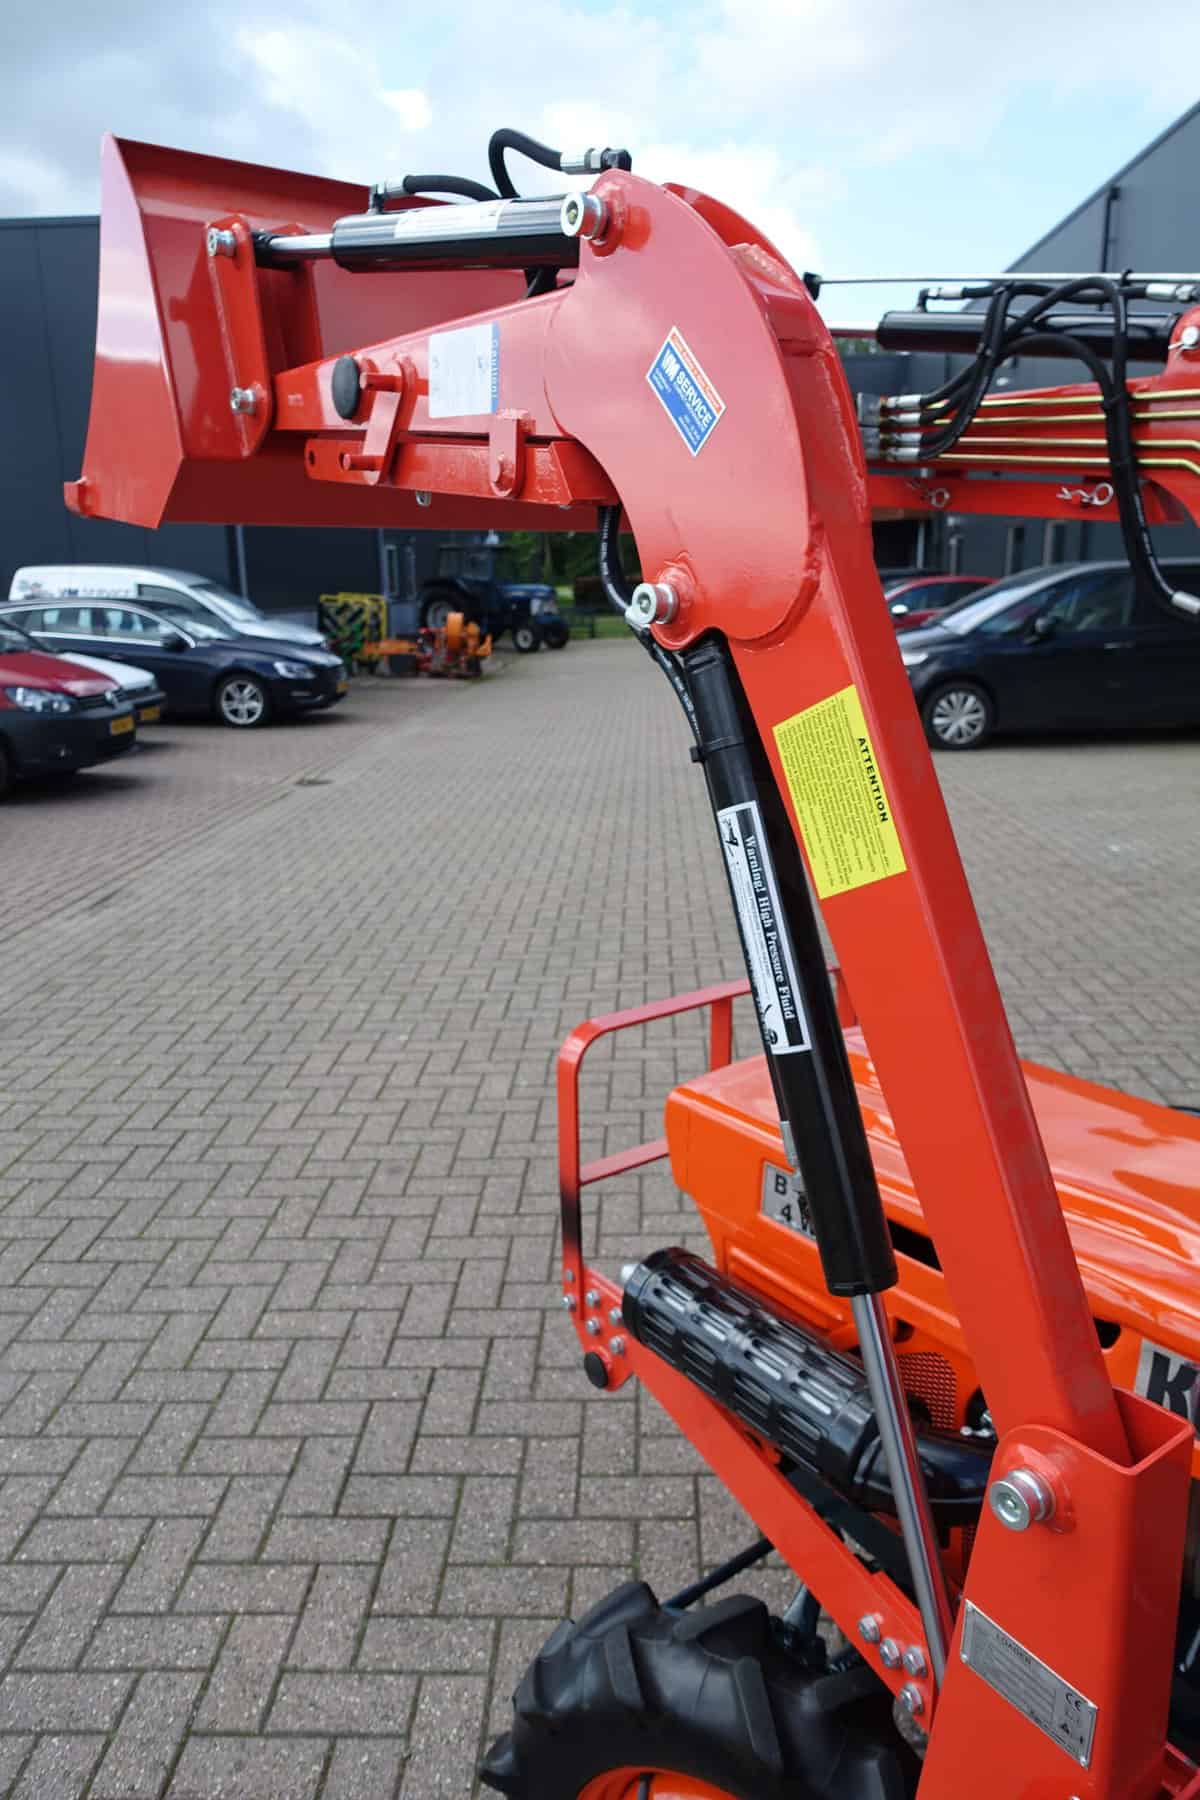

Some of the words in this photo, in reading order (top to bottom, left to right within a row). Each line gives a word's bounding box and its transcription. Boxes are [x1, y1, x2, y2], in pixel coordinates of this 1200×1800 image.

[676, 370, 713, 427] SERVICE
[858, 737, 889, 822] ATTENTION
[745, 835, 767, 892] Warning!
[758, 897, 774, 928] High
[766, 931, 785, 983] Pressure
[778, 985, 796, 1019] Fluid
[1146, 1352, 1200, 1421] K
